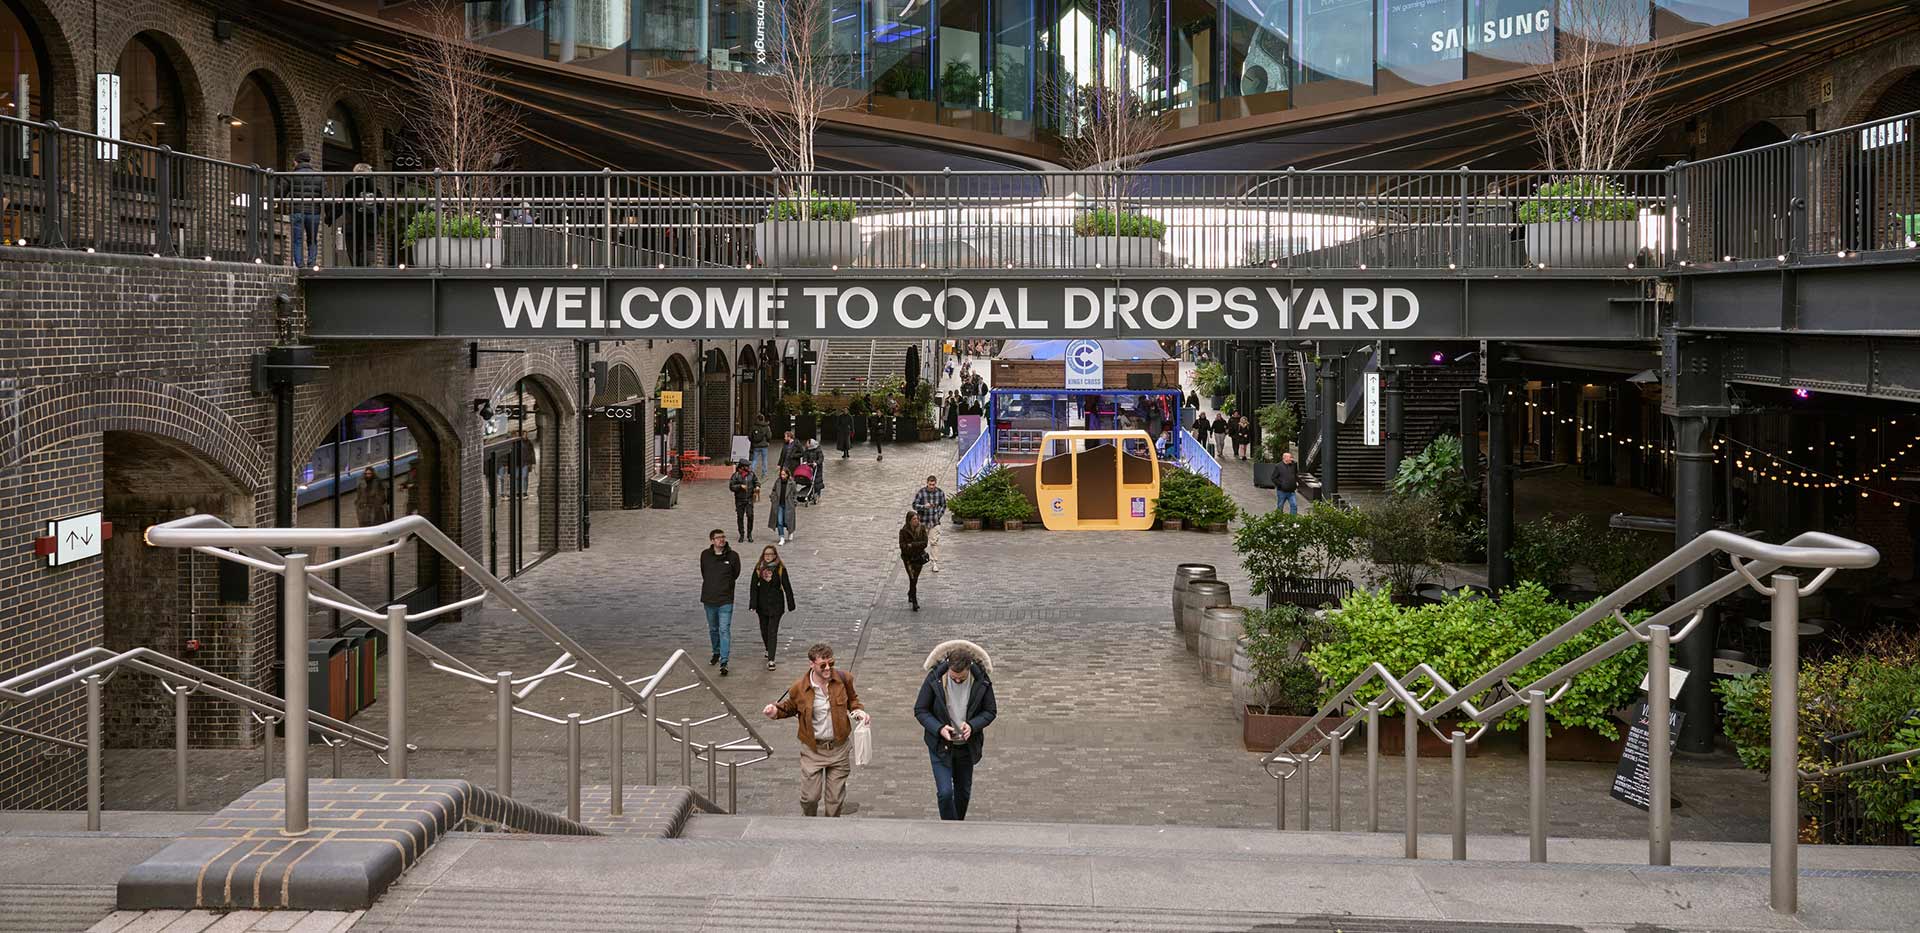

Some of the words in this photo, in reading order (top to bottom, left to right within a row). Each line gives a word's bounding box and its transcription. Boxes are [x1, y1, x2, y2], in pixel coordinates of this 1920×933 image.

[755, 0, 766, 64] amsungKX
[1431, 9, 1550, 52] SAMSUNG
[1823, 82, 1831, 96] 13
[395, 156, 422, 166] COS
[493, 286, 789, 330] WELCOME
[803, 287, 879, 330] TO
[892, 286, 1049, 331] COAL
[1063, 286, 1259, 331] DROPS
[1266, 287, 1420, 331] YARD
[605, 408, 632, 419] COS
